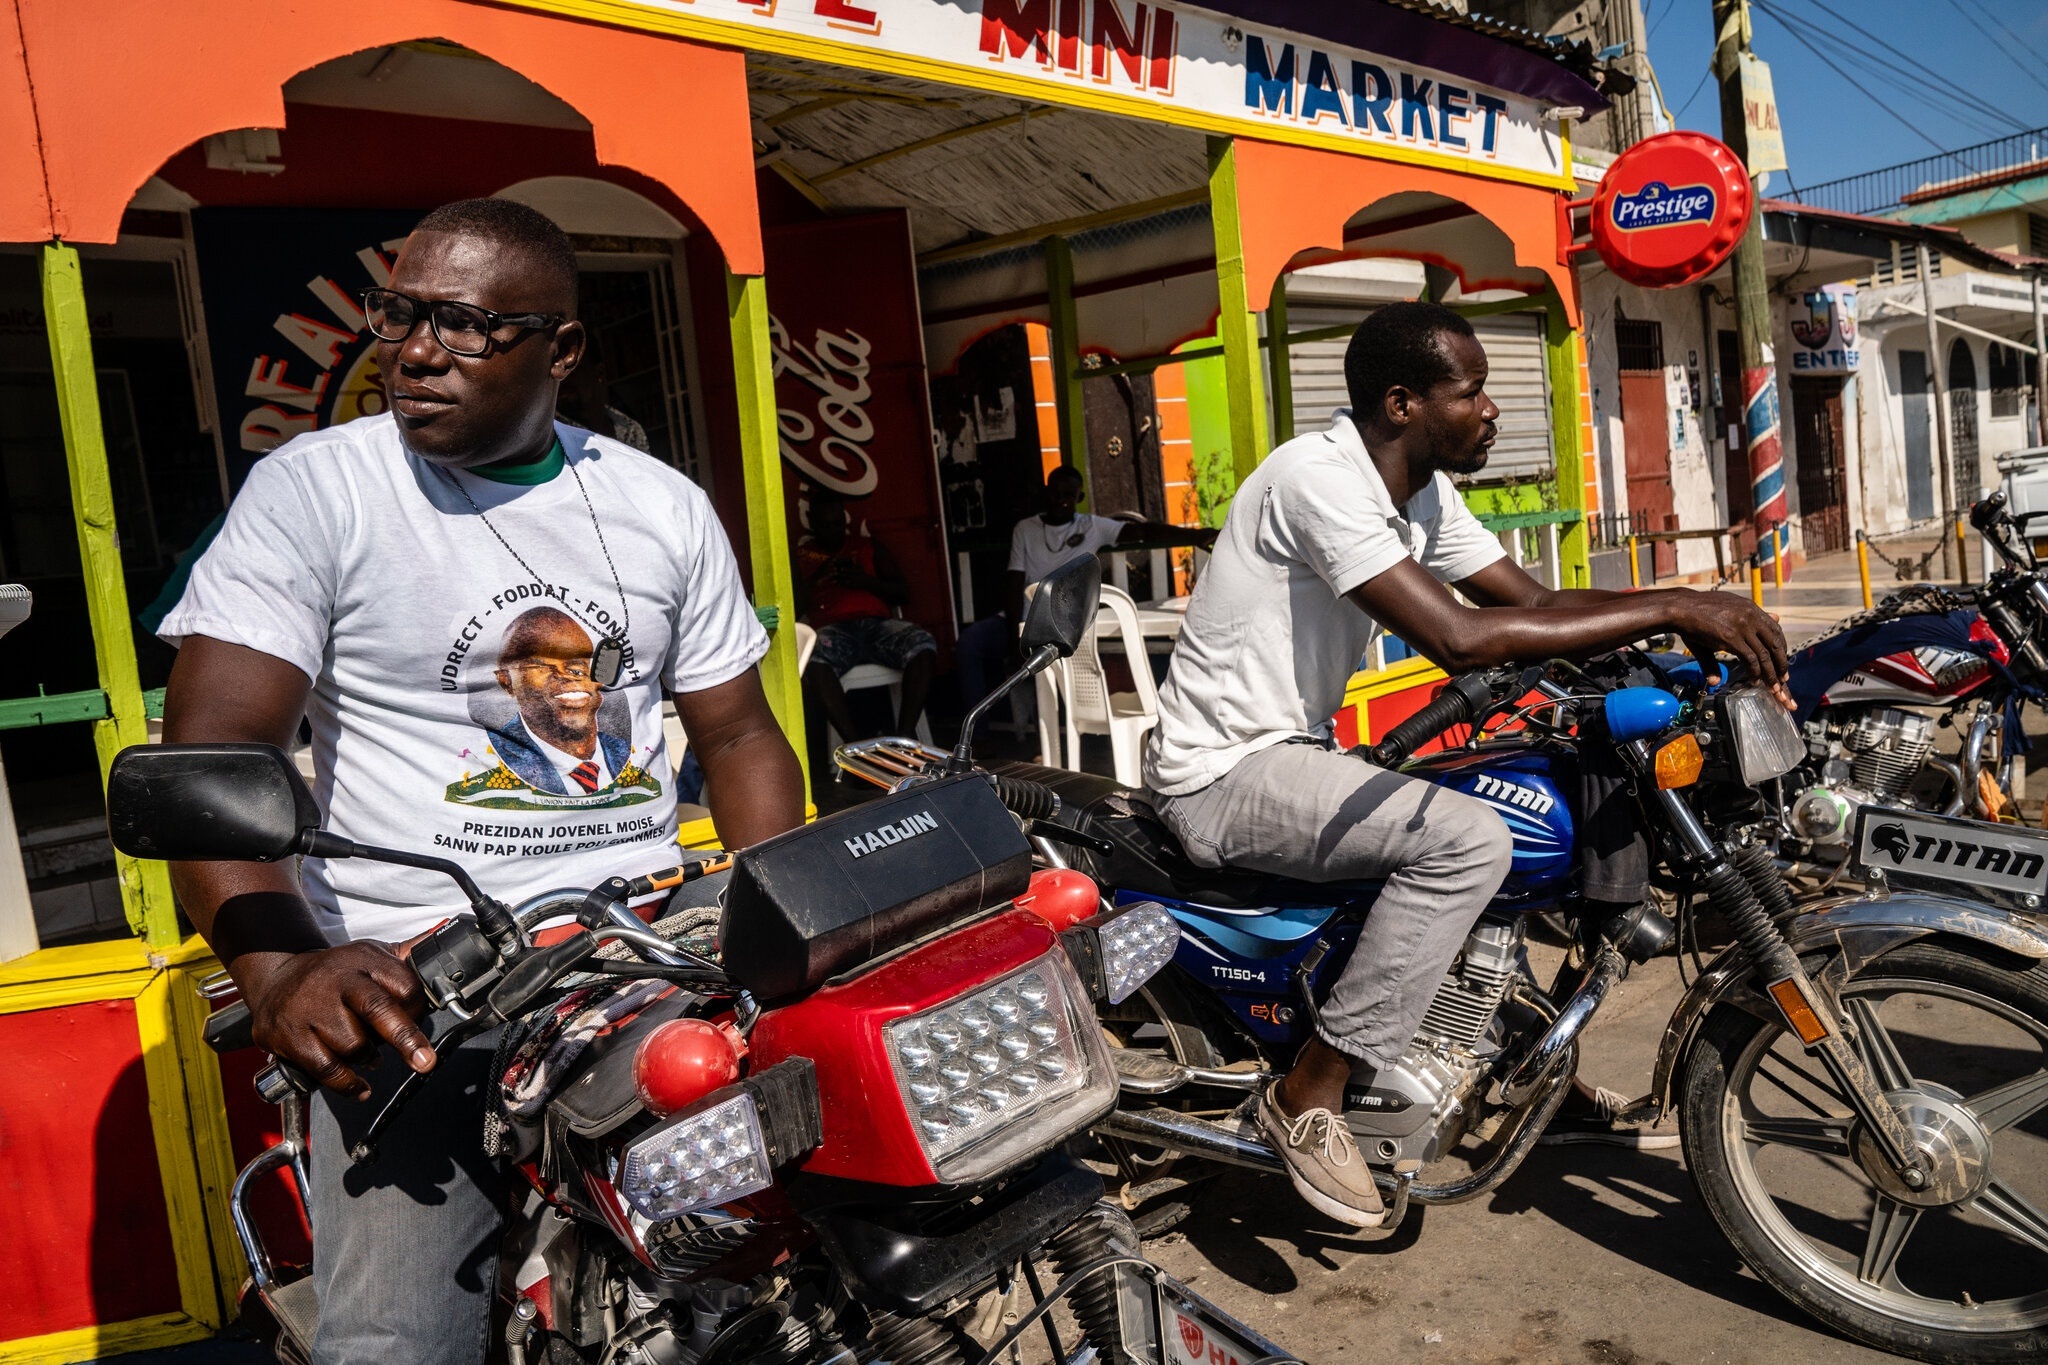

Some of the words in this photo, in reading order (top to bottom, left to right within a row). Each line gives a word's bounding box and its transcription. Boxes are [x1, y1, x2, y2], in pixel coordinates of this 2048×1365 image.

[978, 0, 1177, 94] MINI
[1245, 34, 1507, 156] MARKET
[1618, 193, 1708, 221] Prestige
[440, 615, 484, 691] UDRECT
[492, 583, 570, 609] FODDAT
[1473, 774, 1555, 815] TITAN
[433, 833, 480, 854] SANW
[483, 843, 517, 857] PAP
[521, 843, 573, 857] KOULE
[463, 821, 544, 839] PREZIDAN
[548, 823, 613, 839] JOVENEL
[843, 810, 939, 859] HAOJIN
[1911, 834, 2046, 880] TITAN
[1211, 965, 1267, 983] TT150-4
[1349, 1094, 1383, 1107] TITAN
